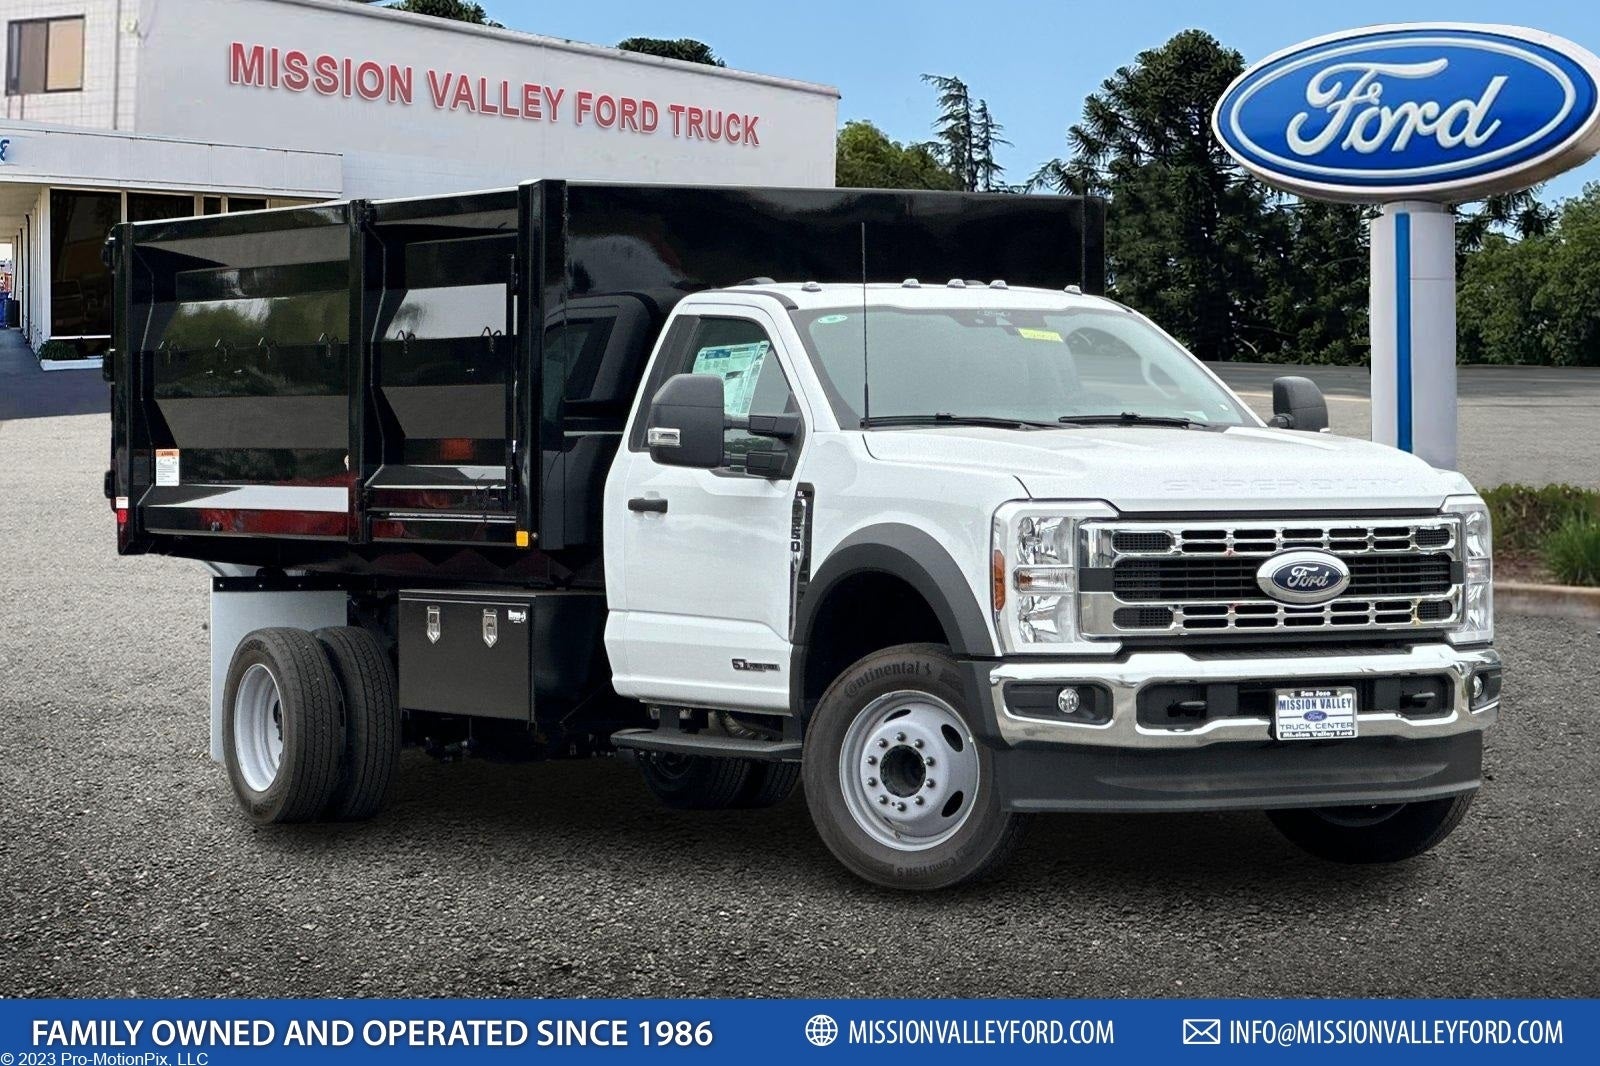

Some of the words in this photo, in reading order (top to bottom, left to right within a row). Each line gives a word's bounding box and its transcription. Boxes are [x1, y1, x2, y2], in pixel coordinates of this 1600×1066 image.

[230, 42, 414, 105] MISSION
[428, 69, 565, 123] VALLEY
[575, 90, 659, 134] FORD
[669, 103, 760, 146] TRUCK
[1286, 57, 1508, 156] Ford
[1287, 566, 1329, 588] Ford
[844, 661, 920, 697] Continental
[1280, 699, 1317, 710] MISSION
[1320, 698, 1352, 709] VALLEY
[1280, 723, 1311, 731] TRUCK
[1315, 721, 1354, 730] CENTER
